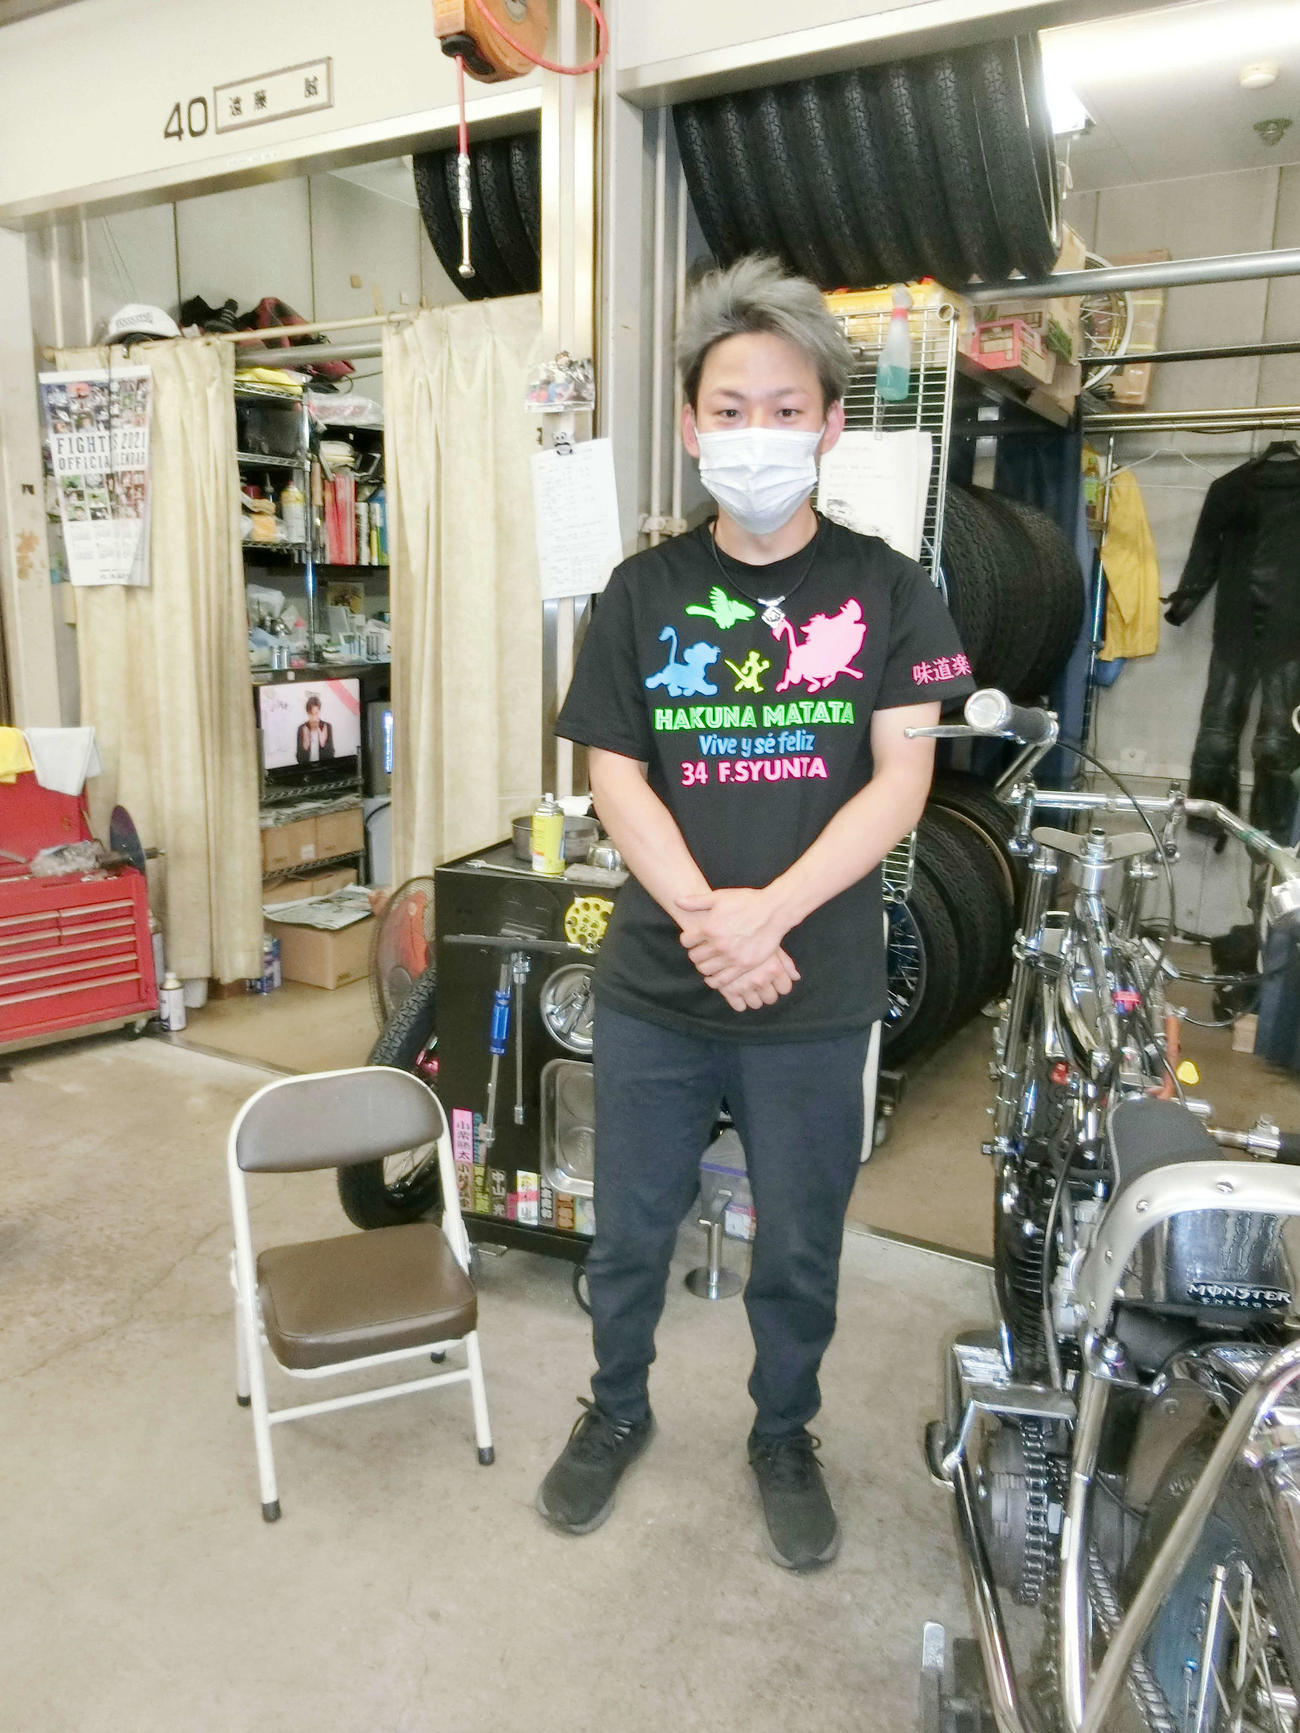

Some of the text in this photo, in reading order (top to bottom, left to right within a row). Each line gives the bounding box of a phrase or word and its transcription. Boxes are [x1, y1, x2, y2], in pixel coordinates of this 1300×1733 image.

[164, 96, 208, 141] 40
[58, 455, 111, 471] OFFICIA
[912, 653, 973, 686] 味道楽
[654, 700, 855, 731] HAKUNA MATATA
[699, 728, 816, 758] Vive y sé feliz
[680, 756, 829, 787] 34 F.SYUNTA
[1187, 1283, 1291, 1304] MONSTER
[1202, 1296, 1275, 1309] ENERGY
